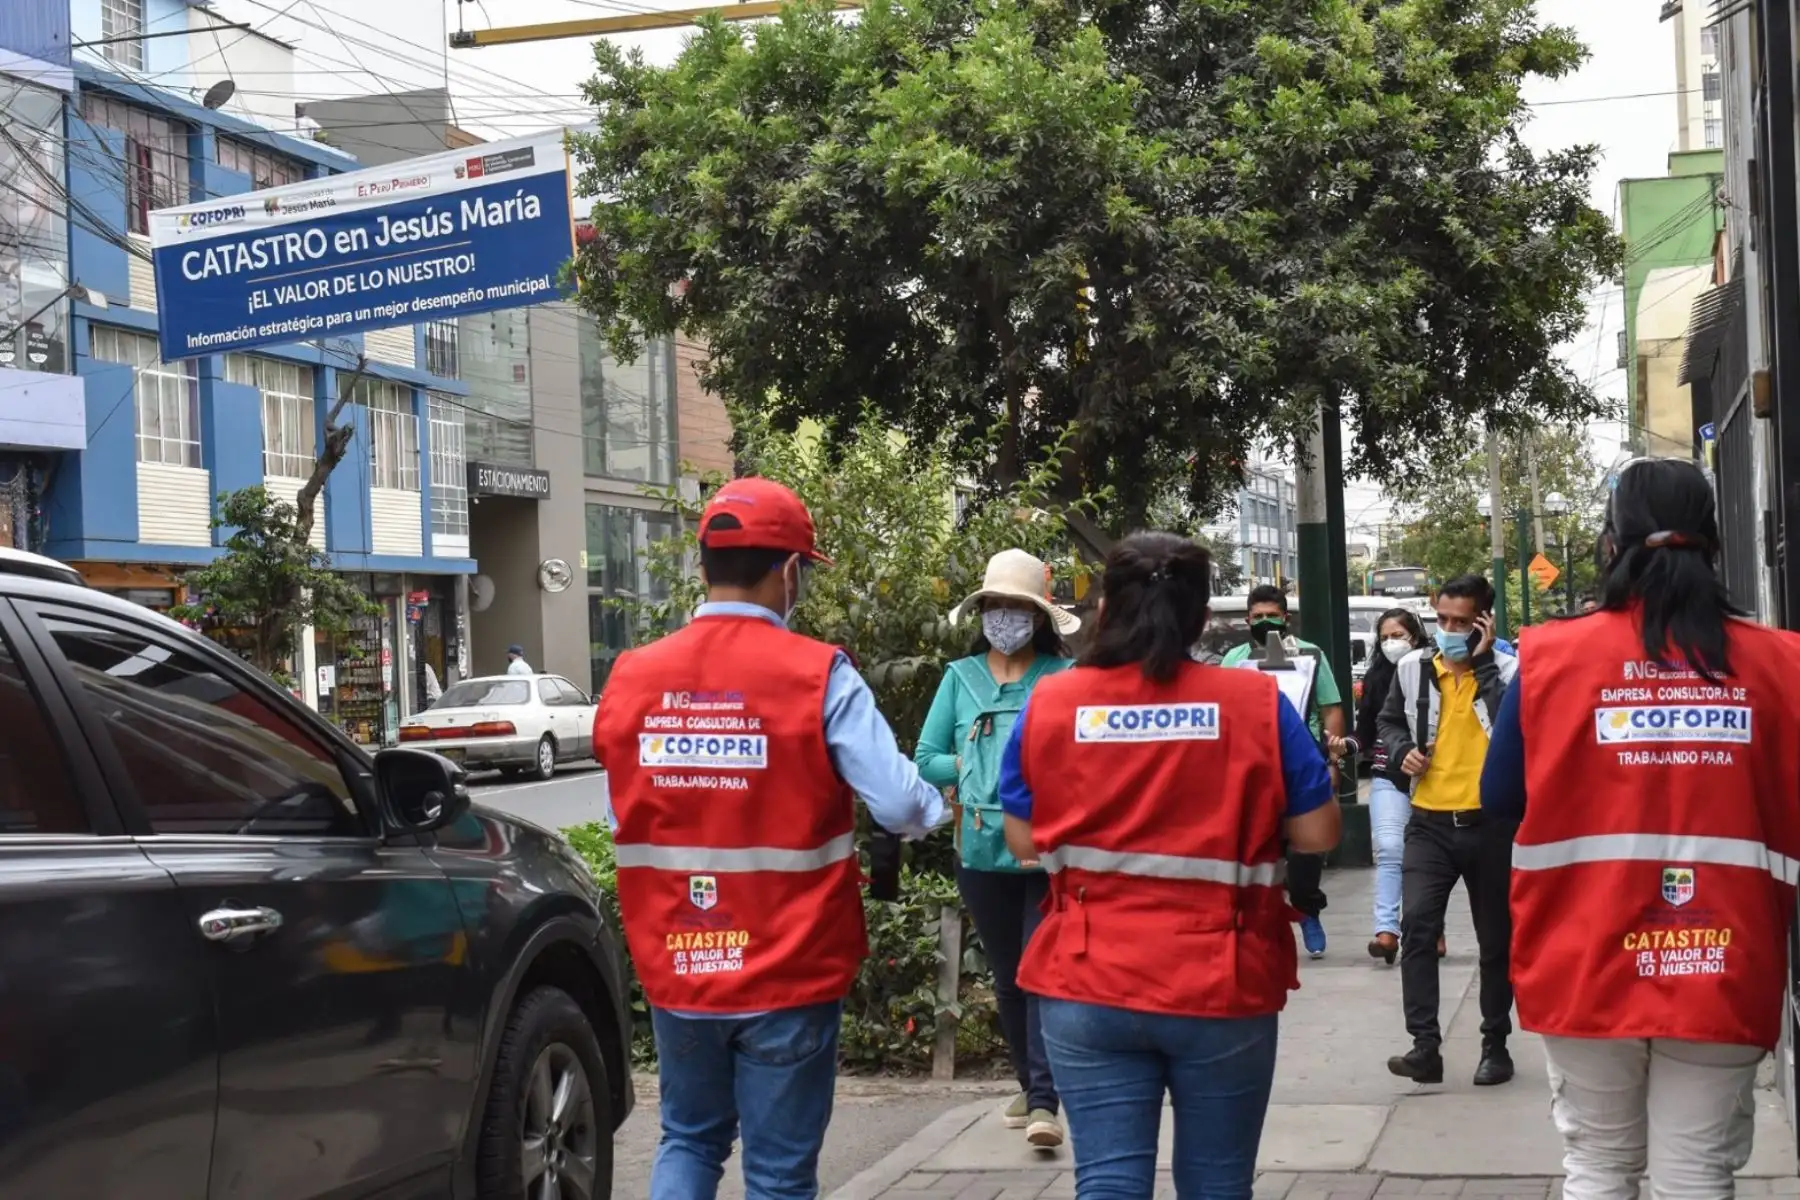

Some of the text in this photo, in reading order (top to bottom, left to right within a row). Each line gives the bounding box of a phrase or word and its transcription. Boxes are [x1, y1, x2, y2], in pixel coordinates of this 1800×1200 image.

[310, 197, 336, 210] María
[190, 206, 245, 226] COFOPRI
[182, 189, 541, 281] CATASTRO en Jesús María
[248, 253, 476, 314] ¡EL VALOR DE LO NUESTRO!
[187, 274, 550, 348] Información estratégica para un mejor desempeño municipal
[478, 468, 548, 493] ESTACIONAMIENTO
[1601, 686, 1746, 702] EMPRESA CONSULTORA DE
[644, 716, 761, 730] EMPRESA CONSULTORA DE
[1108, 708, 1216, 730] COFOPRI
[1630, 708, 1747, 730] COFOPRI
[665, 736, 762, 756] COFOPRI
[1617, 751, 1734, 765] TRABAJANDO PARA
[652, 774, 748, 790] TRABAJANDO PARA
[666, 930, 750, 950] CATASTRO
[1623, 928, 1732, 950] CATASTRO
[690, 948, 724, 962] VALOR
[728, 948, 743, 959] DE
[1660, 948, 1702, 962] VALOR
[1706, 947, 1724, 960] DE
[676, 962, 688, 975] LO
[1638, 960, 1725, 976] LO NUESTRO!
